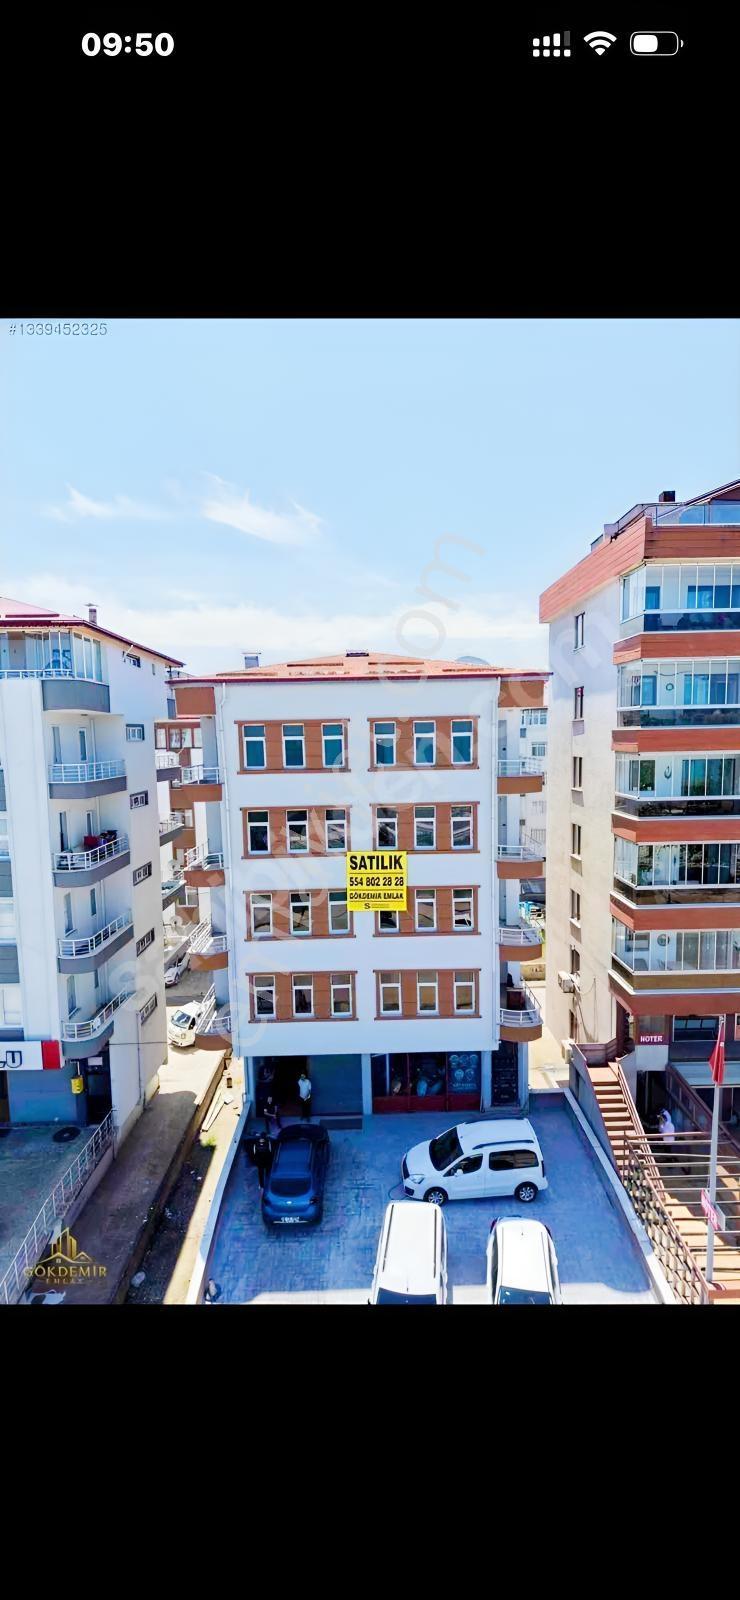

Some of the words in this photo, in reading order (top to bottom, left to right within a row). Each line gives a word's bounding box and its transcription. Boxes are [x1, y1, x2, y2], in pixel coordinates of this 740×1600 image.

[349, 855, 403, 870] SATILIK
[349, 877, 364, 886] 554
[366, 876, 381, 886] 802
[382, 876, 392, 886] 28
[394, 876, 404, 886] 28
[640, 1035, 663, 1043] NOTER
